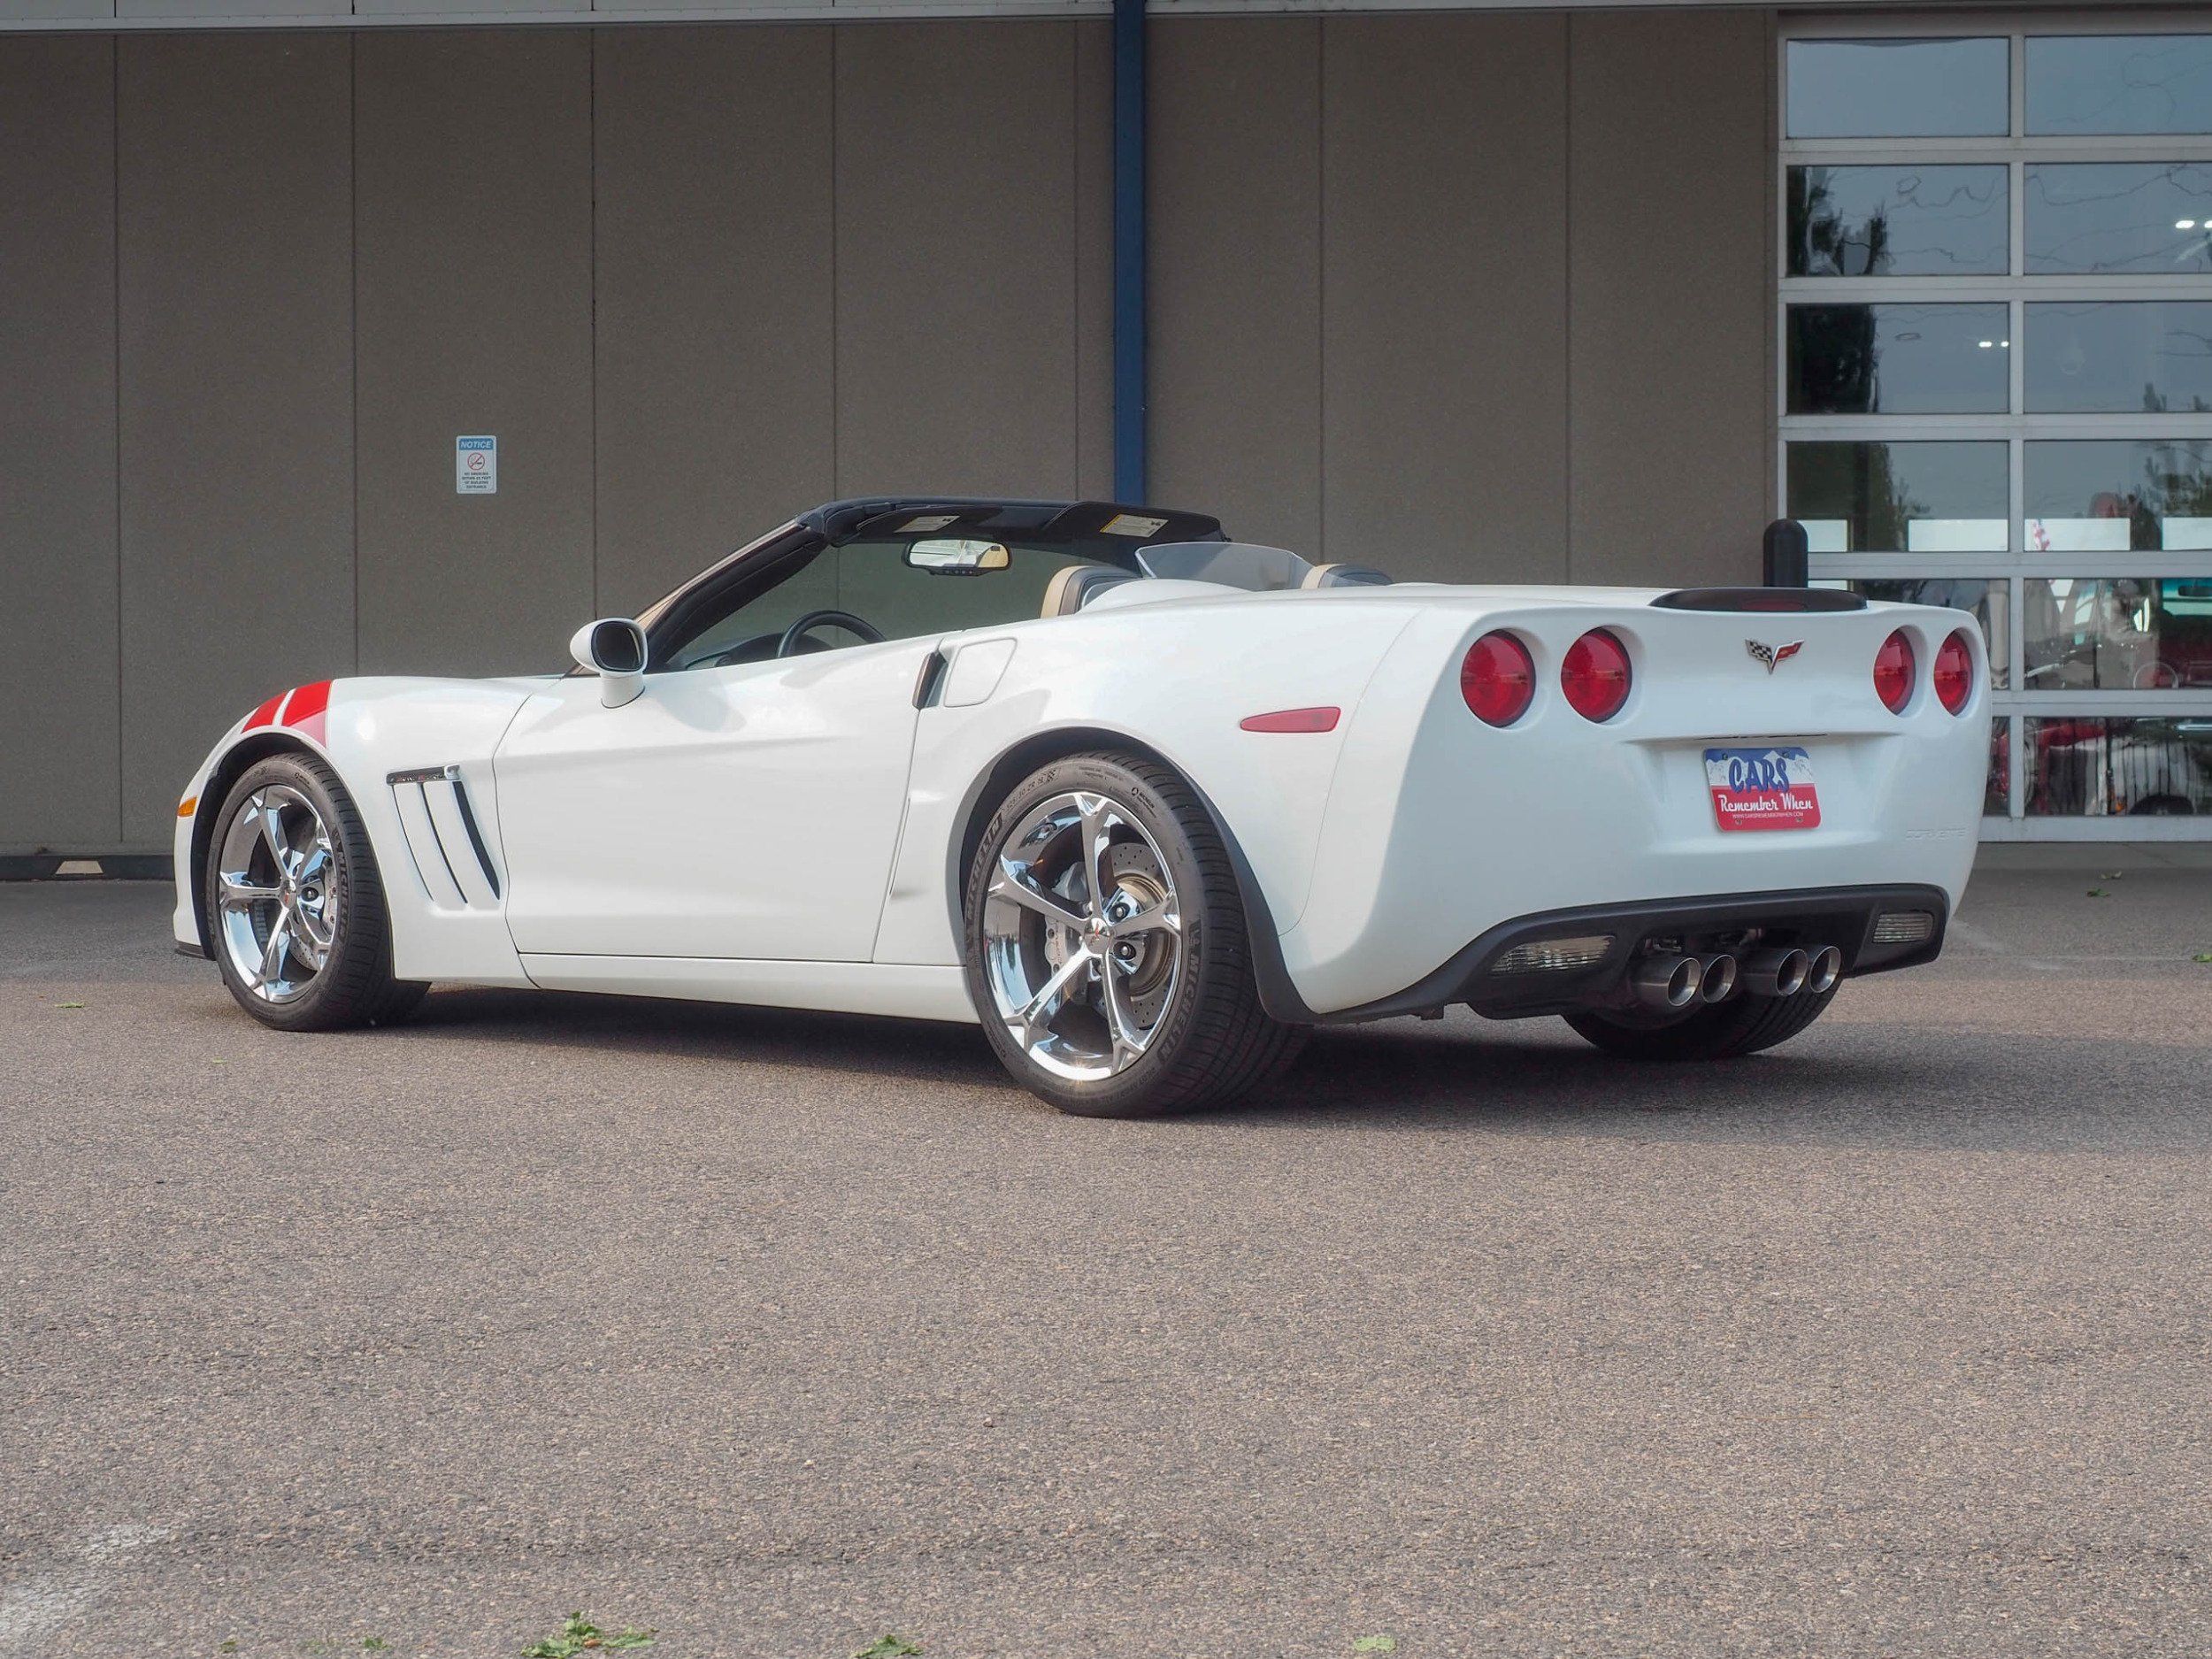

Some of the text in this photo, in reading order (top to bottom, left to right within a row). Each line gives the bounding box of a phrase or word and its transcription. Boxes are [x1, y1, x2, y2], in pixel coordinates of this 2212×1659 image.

[1728, 757, 1790, 793] CARS
[1717, 792, 1814, 812] Remember When
